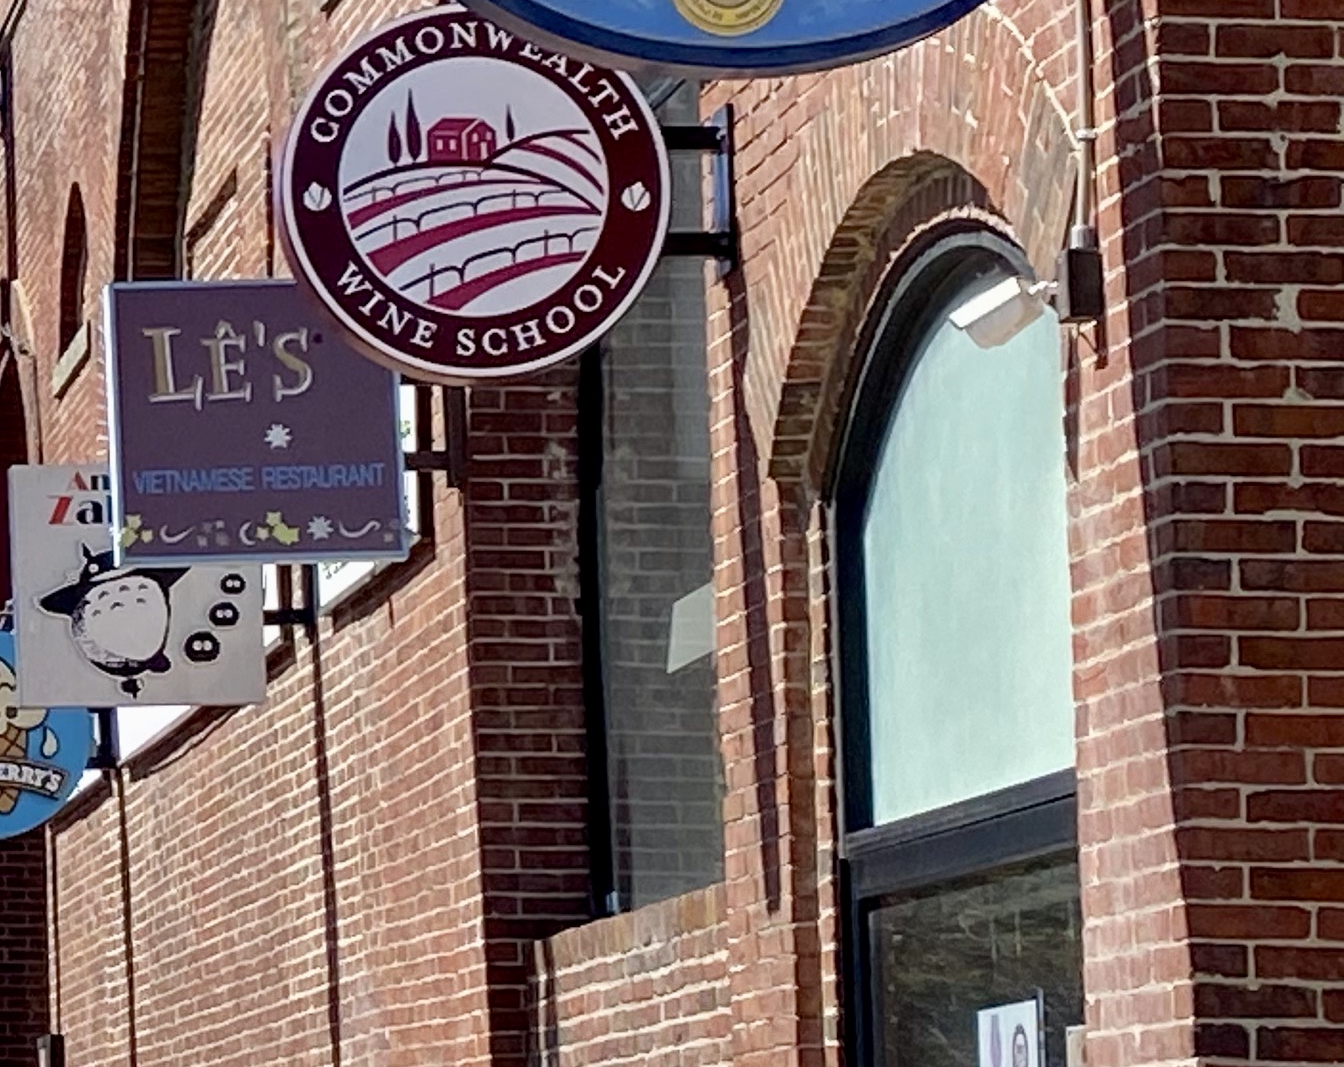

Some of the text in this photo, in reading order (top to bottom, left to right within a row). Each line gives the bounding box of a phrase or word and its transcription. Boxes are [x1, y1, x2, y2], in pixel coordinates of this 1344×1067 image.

[310, 21, 640, 144] COMMONWEALTH
[337, 261, 627, 358] WINE SCHOOL
[133, 463, 386, 494] VIETNAMESE RESTAURANT
